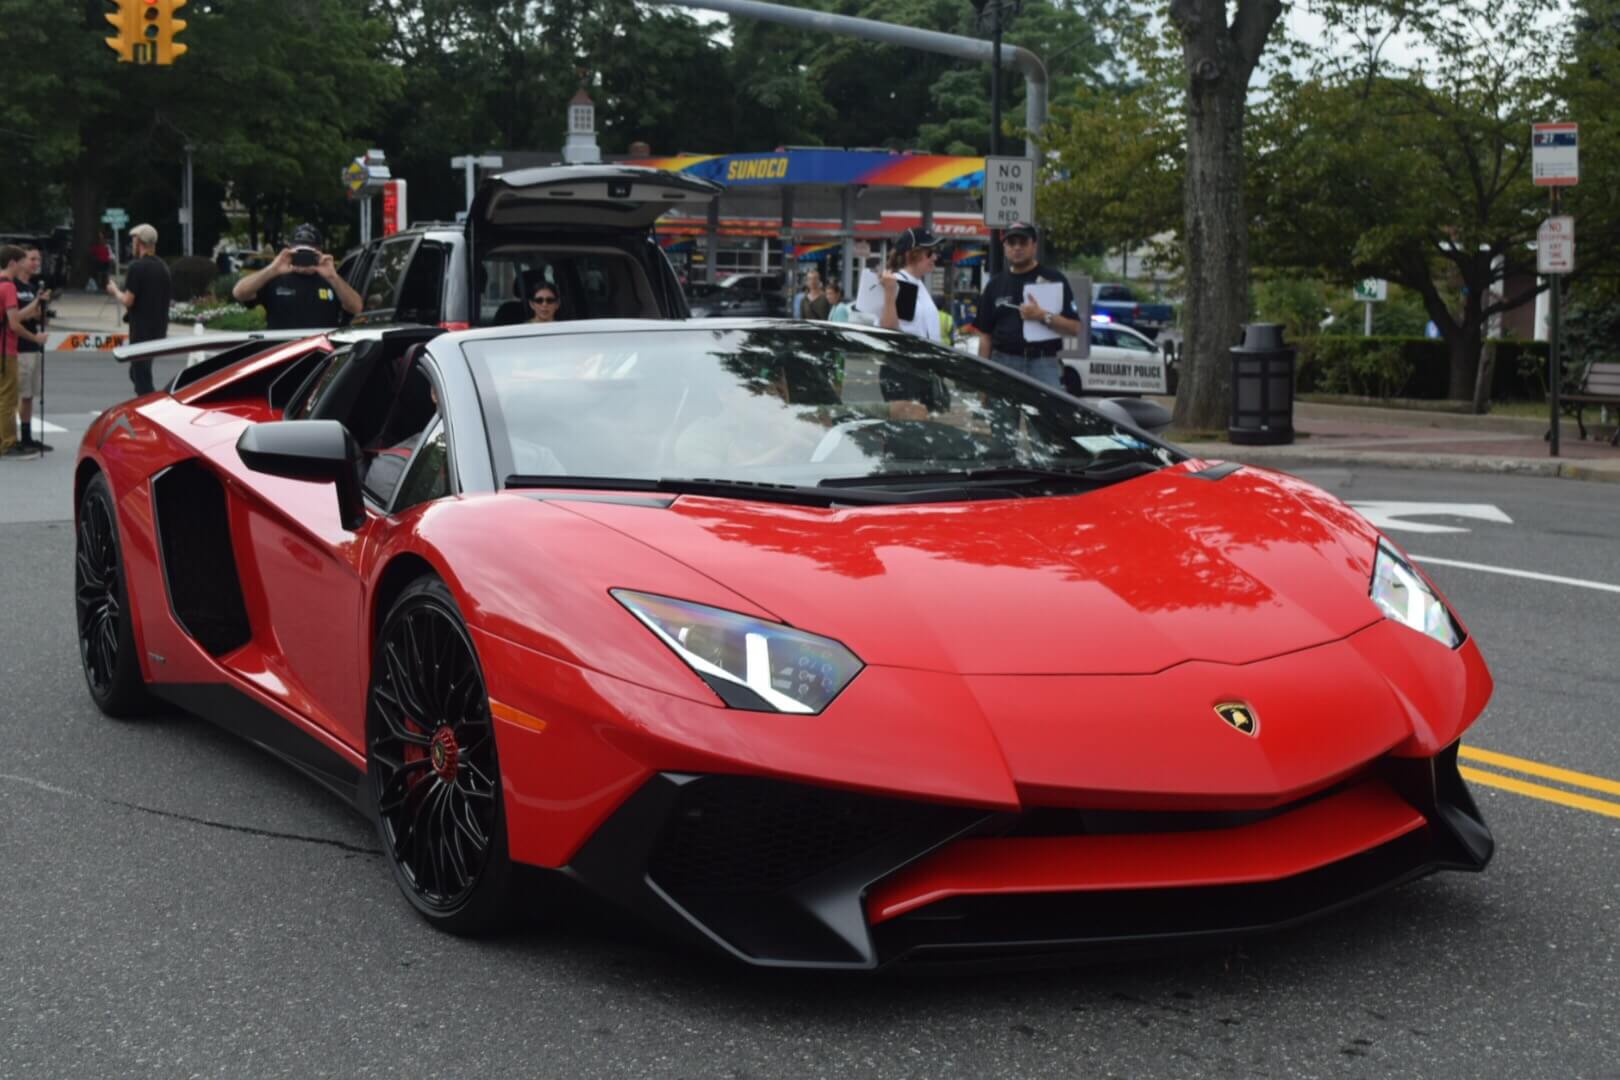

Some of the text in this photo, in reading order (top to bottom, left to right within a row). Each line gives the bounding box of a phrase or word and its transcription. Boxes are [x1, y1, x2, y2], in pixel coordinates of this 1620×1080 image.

[728, 158, 788, 180] SUNOCO
[999, 164, 1021, 178] NO
[995, 181, 1023, 193] TURN
[1000, 195, 1017, 207] ON
[998, 210, 1020, 222] RED
[1549, 223, 1562, 233] NO
[1089, 362, 1162, 379] AUXILIARY POLICE
